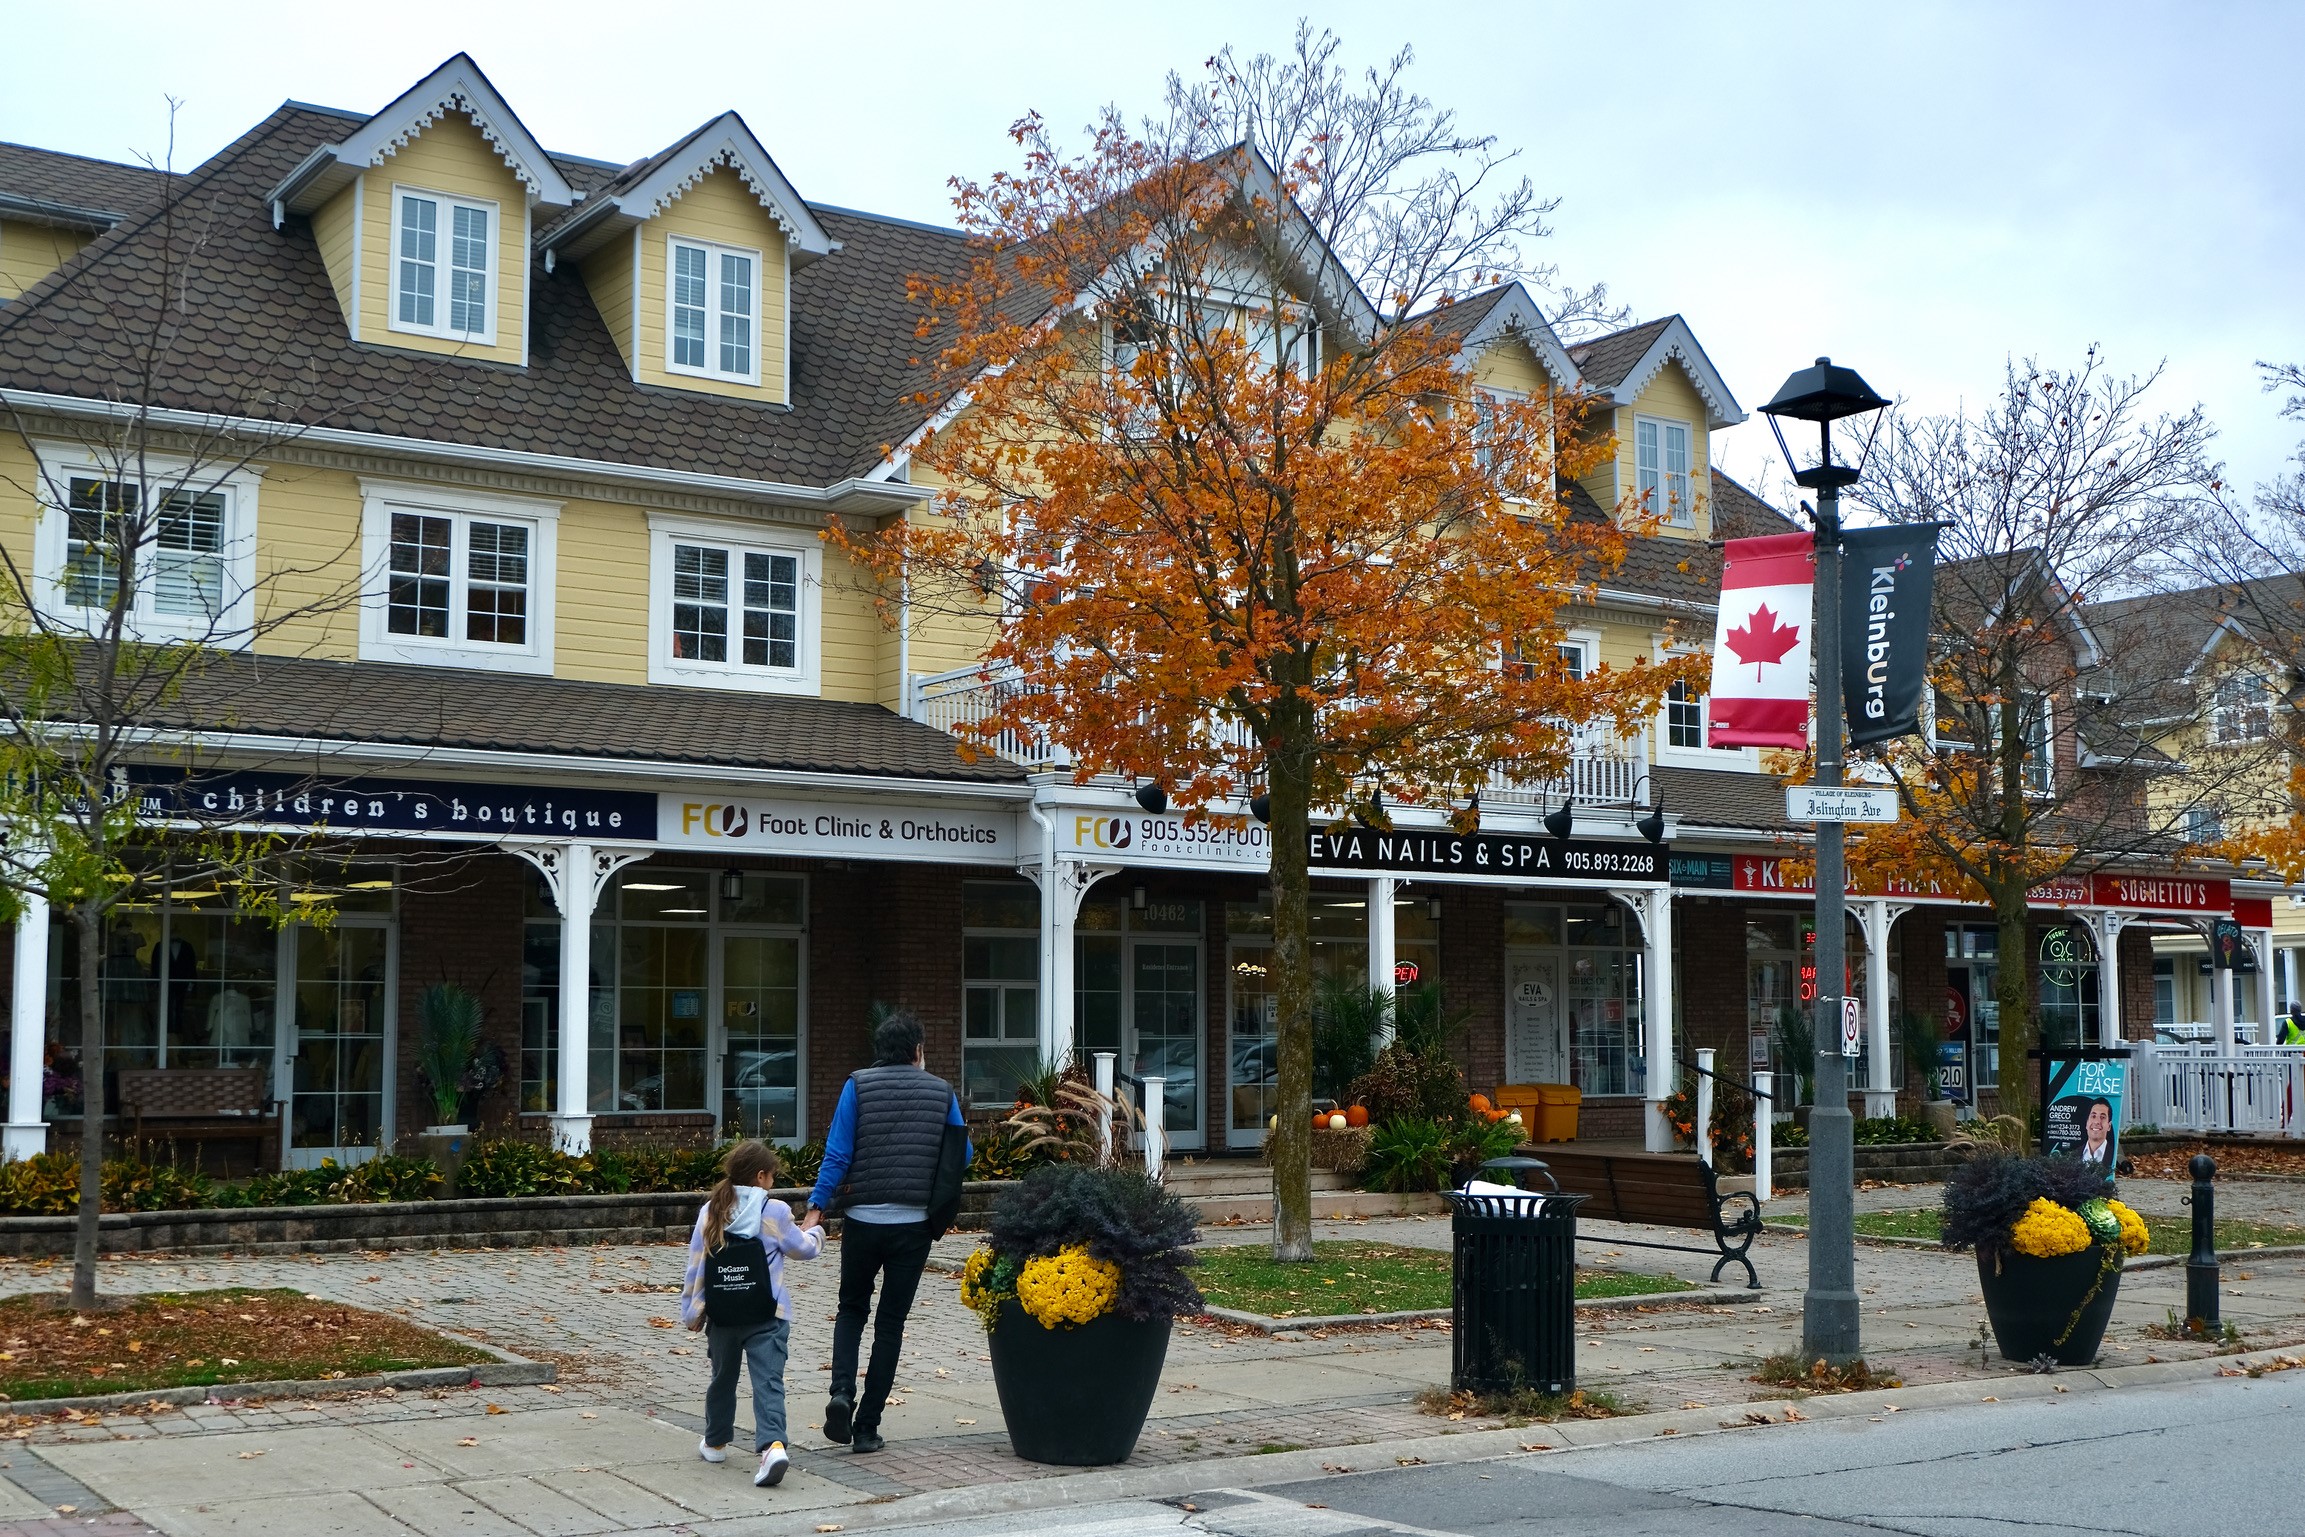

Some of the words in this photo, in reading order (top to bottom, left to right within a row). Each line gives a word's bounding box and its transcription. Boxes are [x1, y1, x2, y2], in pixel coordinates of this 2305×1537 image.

[203, 786, 428, 819] children's
[451, 797, 622, 831] boutique
[1806, 798, 1857, 820] Islington
[1861, 800, 1882, 820] Ave
[760, 813, 808, 835] Foot
[815, 815, 872, 839] Clinic
[878, 820, 893, 839] &
[901, 819, 997, 844] Orthotics
[1310, 834, 1363, 860] EVA
[1378, 837, 1463, 864] NAILS
[1475, 843, 1490, 865] &
[1501, 844, 1551, 868] SPA
[1564, 852, 1654, 873] 905.893.2268
[1393, 967, 1419, 981] PEN
[1524, 984, 1542, 995] EVA
[2079, 1063, 2106, 1077] FOR
[2077, 1077, 2121, 1094] LEASE
[2049, 1105, 2077, 1113] ANDREW
[2049, 1112, 2071, 1120] GRECO
[717, 1265, 750, 1274] DeGazon
[723, 1274, 745, 1282] Music
